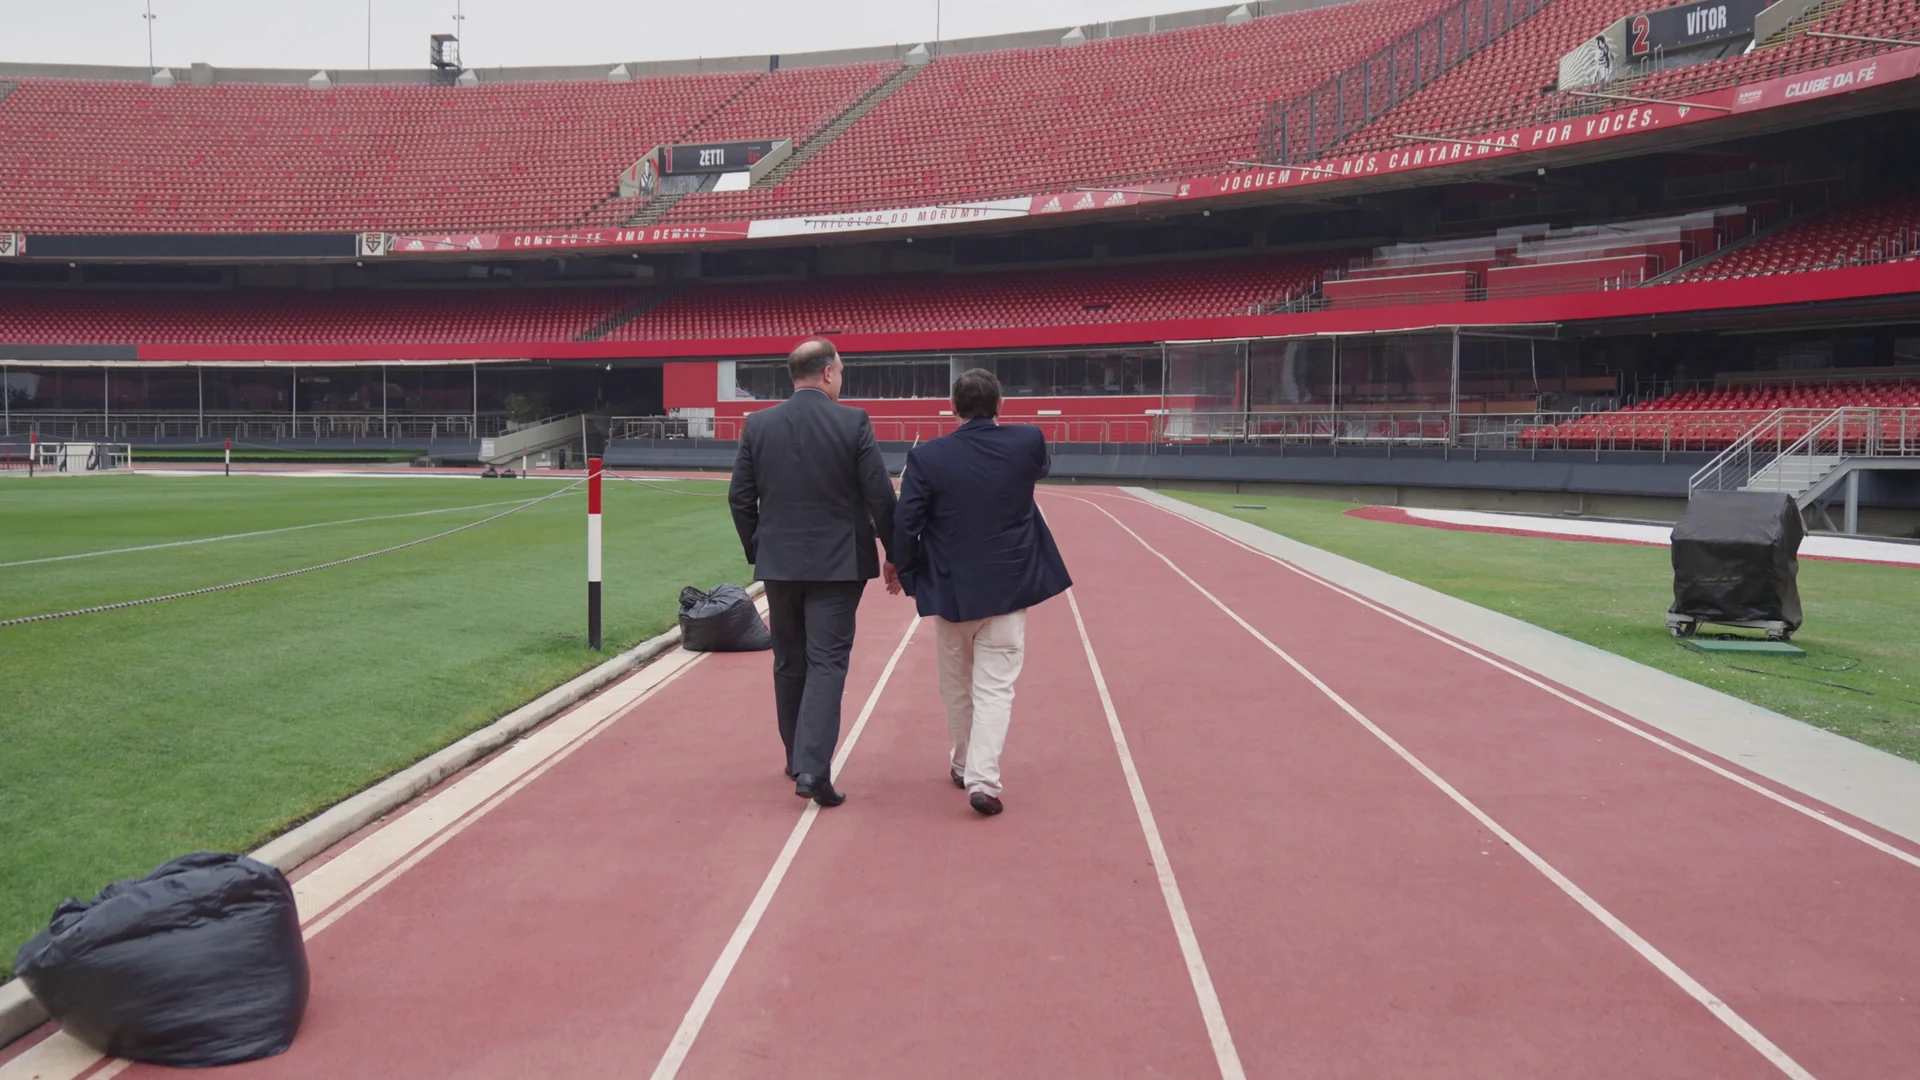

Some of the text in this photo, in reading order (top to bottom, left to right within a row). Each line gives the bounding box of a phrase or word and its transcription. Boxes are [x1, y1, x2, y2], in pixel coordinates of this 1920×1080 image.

[1632, 5, 1727, 55] 2 VÍTOR
[1785, 75, 1831, 98] CLUBE
[1833, 71, 1854, 88] DA
[1856, 62, 1877, 83] FÉ
[664, 147, 673, 173] 1
[699, 149, 725, 166] ZETTI
[1220, 109, 1659, 192] JOGUEM POR NÓS, CANTAREMOS POR VOCÊS.
[813, 206, 988, 229] TRICOLOR DO MORUMBI
[514, 227, 706, 246] COMO EU TE AMO DEMAIS
